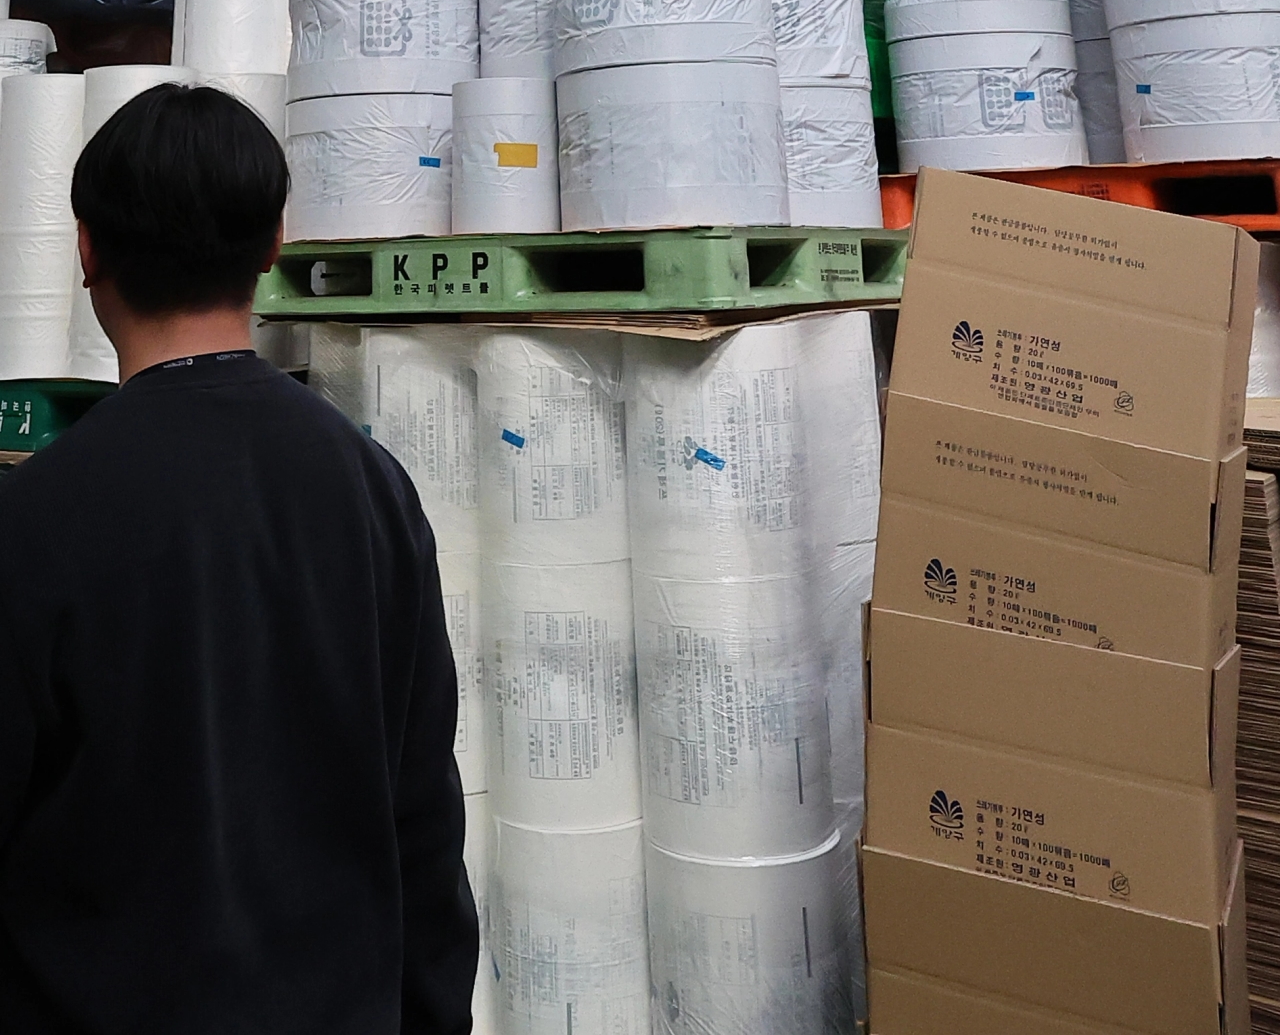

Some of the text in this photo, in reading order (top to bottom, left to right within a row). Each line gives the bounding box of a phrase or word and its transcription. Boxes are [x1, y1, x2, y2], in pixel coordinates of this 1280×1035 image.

[393, 252, 489, 280] KPP
[393, 282, 491, 295] 한국파렛트풀
[1029, 335, 1061, 352] 가연성
[951, 350, 982, 364] 계양구
[1004, 576, 1036, 593] 가연성
